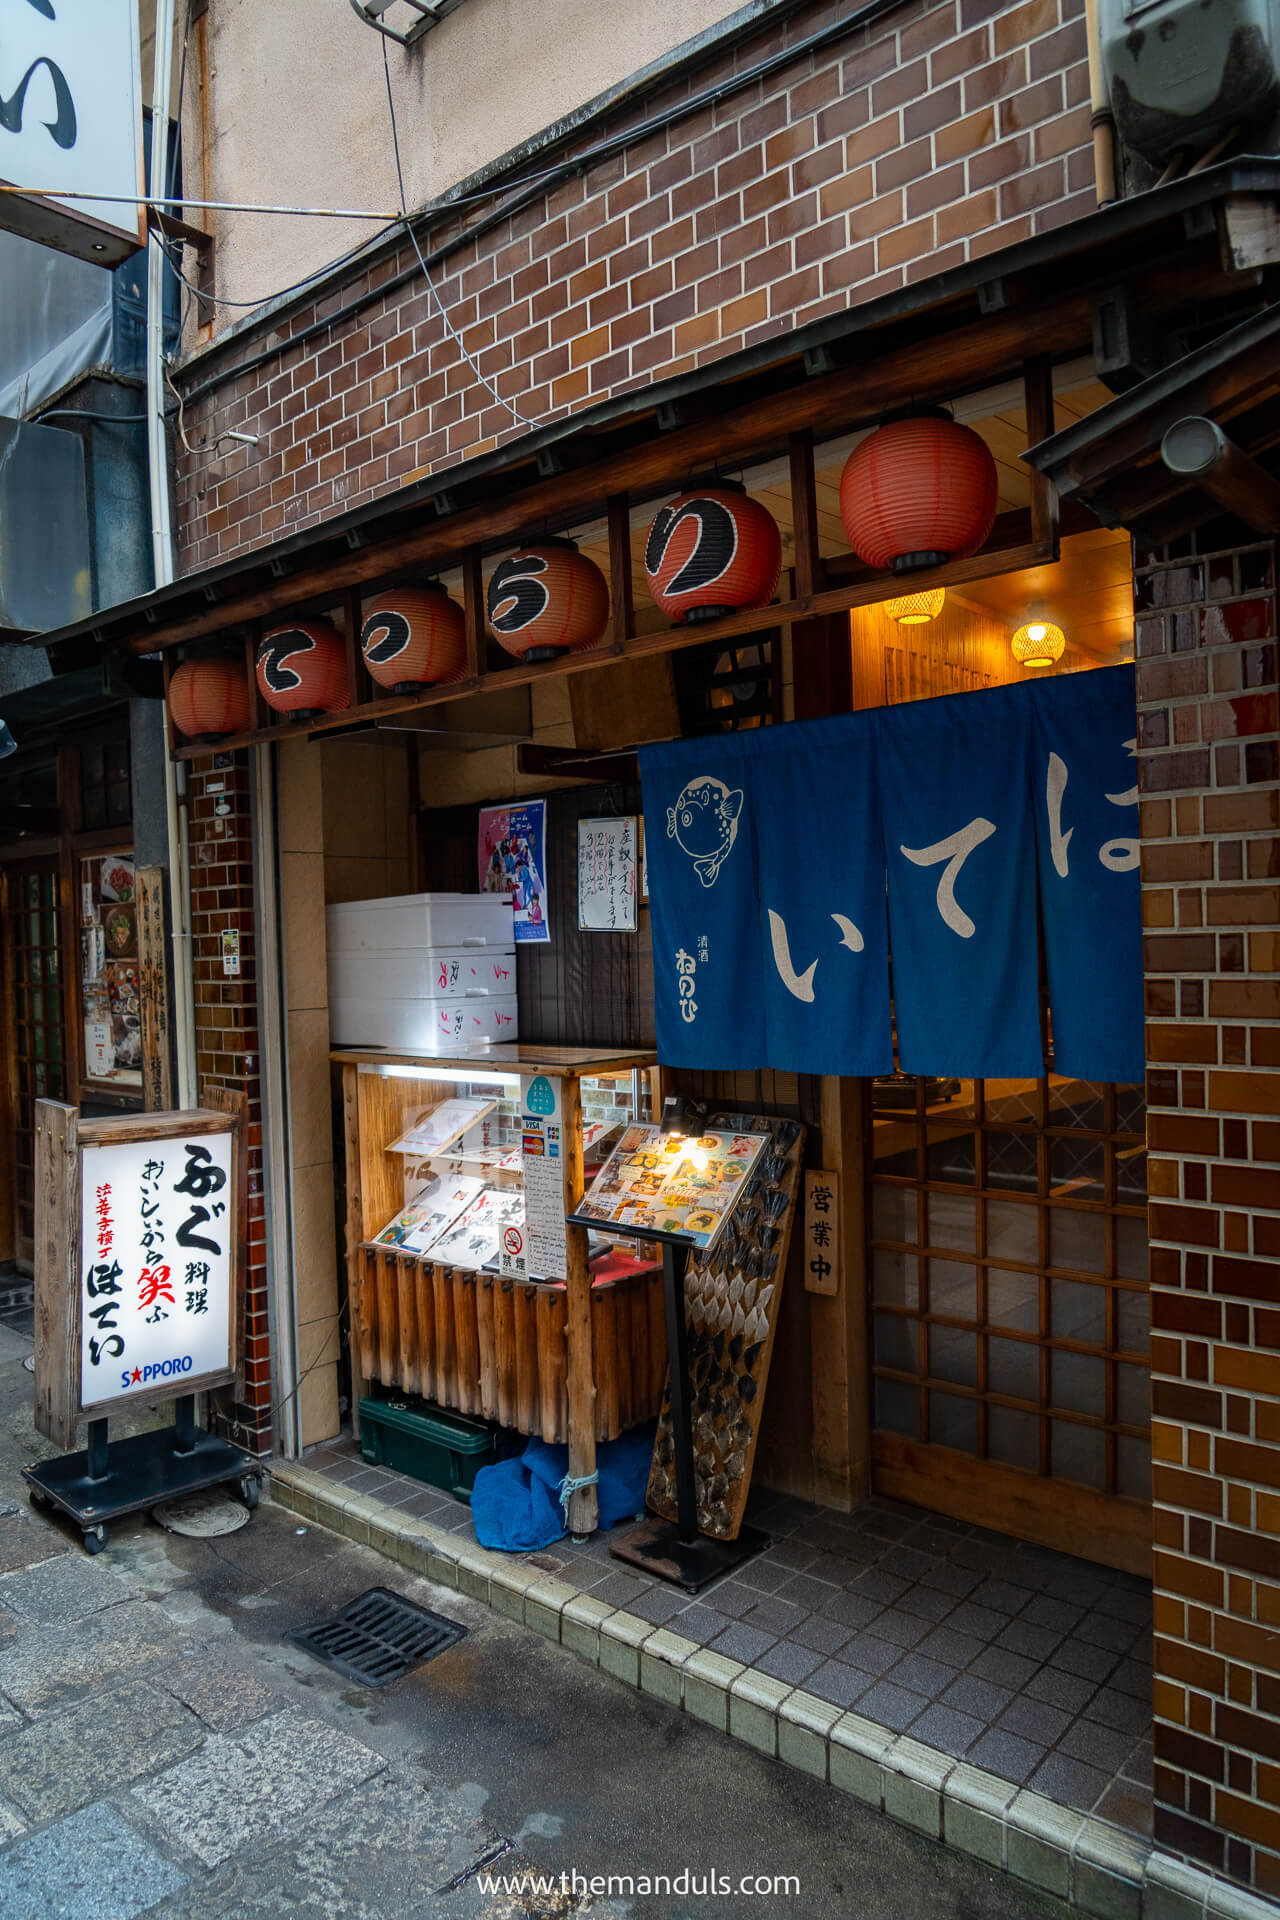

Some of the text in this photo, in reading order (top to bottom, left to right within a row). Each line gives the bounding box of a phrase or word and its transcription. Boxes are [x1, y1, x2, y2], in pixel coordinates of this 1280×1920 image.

[257, 628, 315, 693] て
[644, 497, 739, 597] り
[525, 1120, 540, 1130] VISA
[809, 1185, 833, 1281] 営業中
[86, 1259, 125, 1367] ほてい
